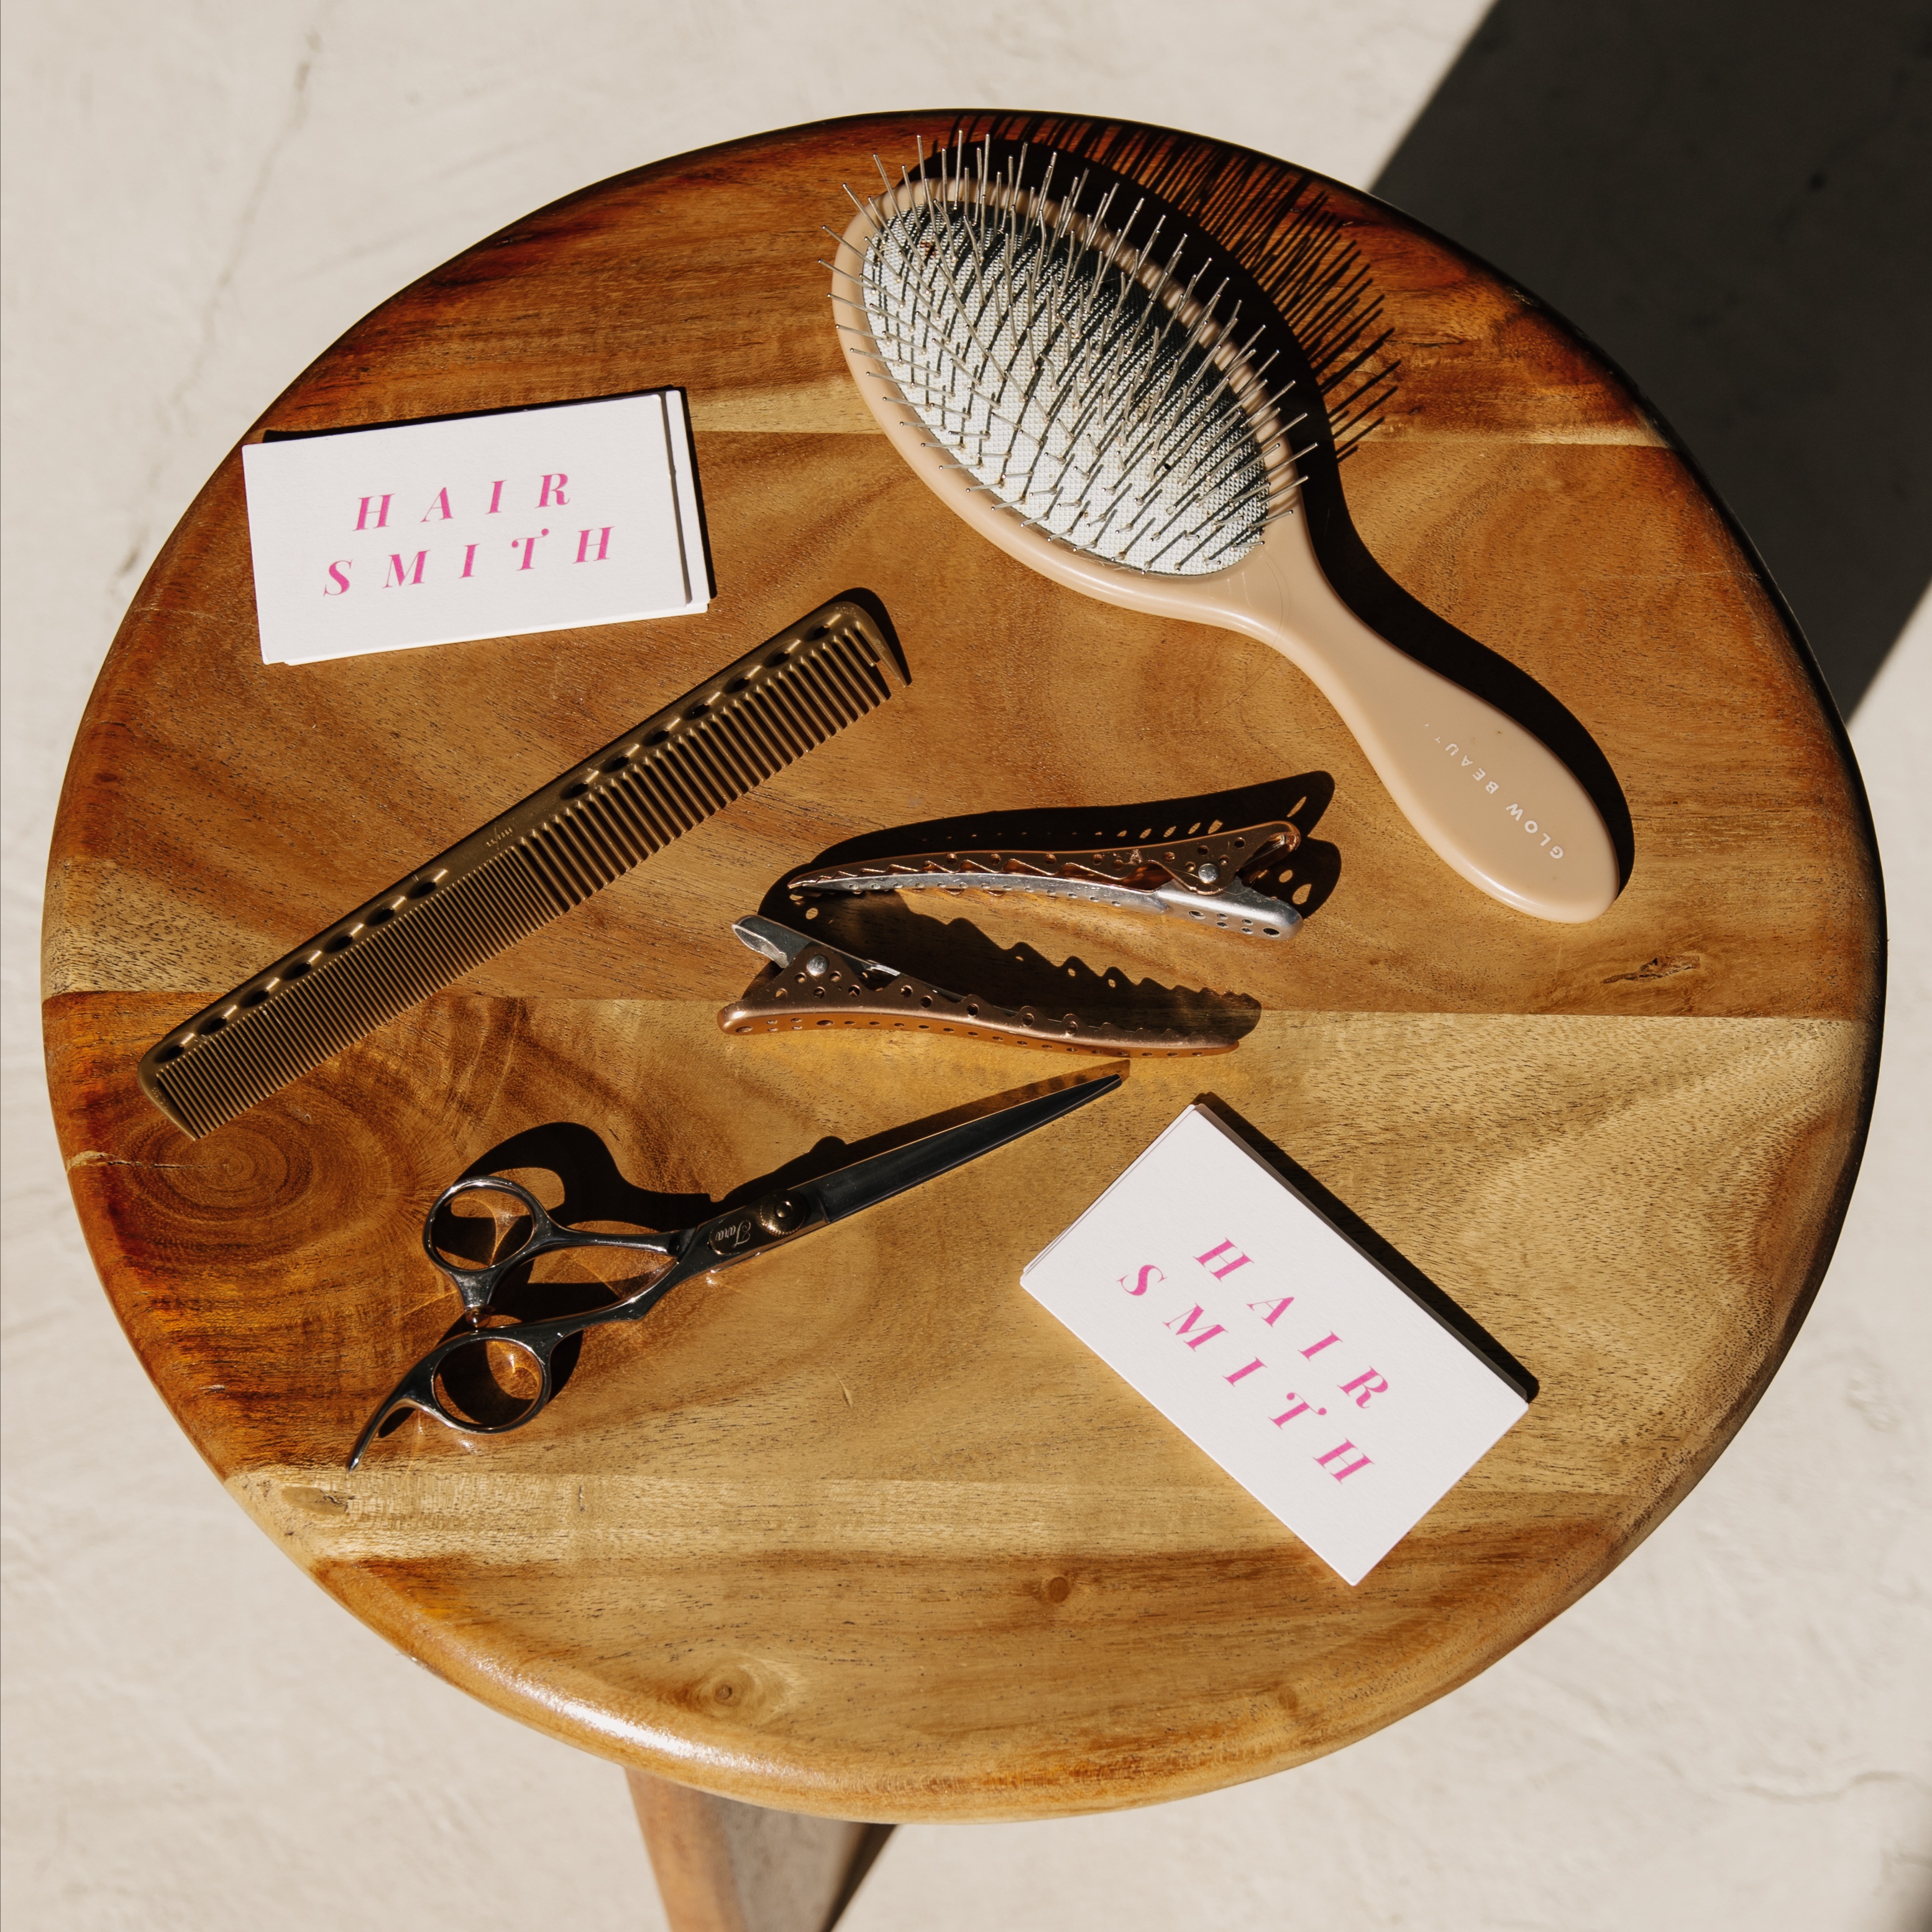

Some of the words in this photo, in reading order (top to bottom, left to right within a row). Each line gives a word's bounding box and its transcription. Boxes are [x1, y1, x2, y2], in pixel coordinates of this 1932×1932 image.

[352, 473, 570, 531] HAIR
[323, 526, 615, 597] SMITH
[1506, 803, 1564, 859] GLOW
[1193, 1237, 1389, 1409] HAIR
[1117, 1263, 1375, 1484] SMITH
